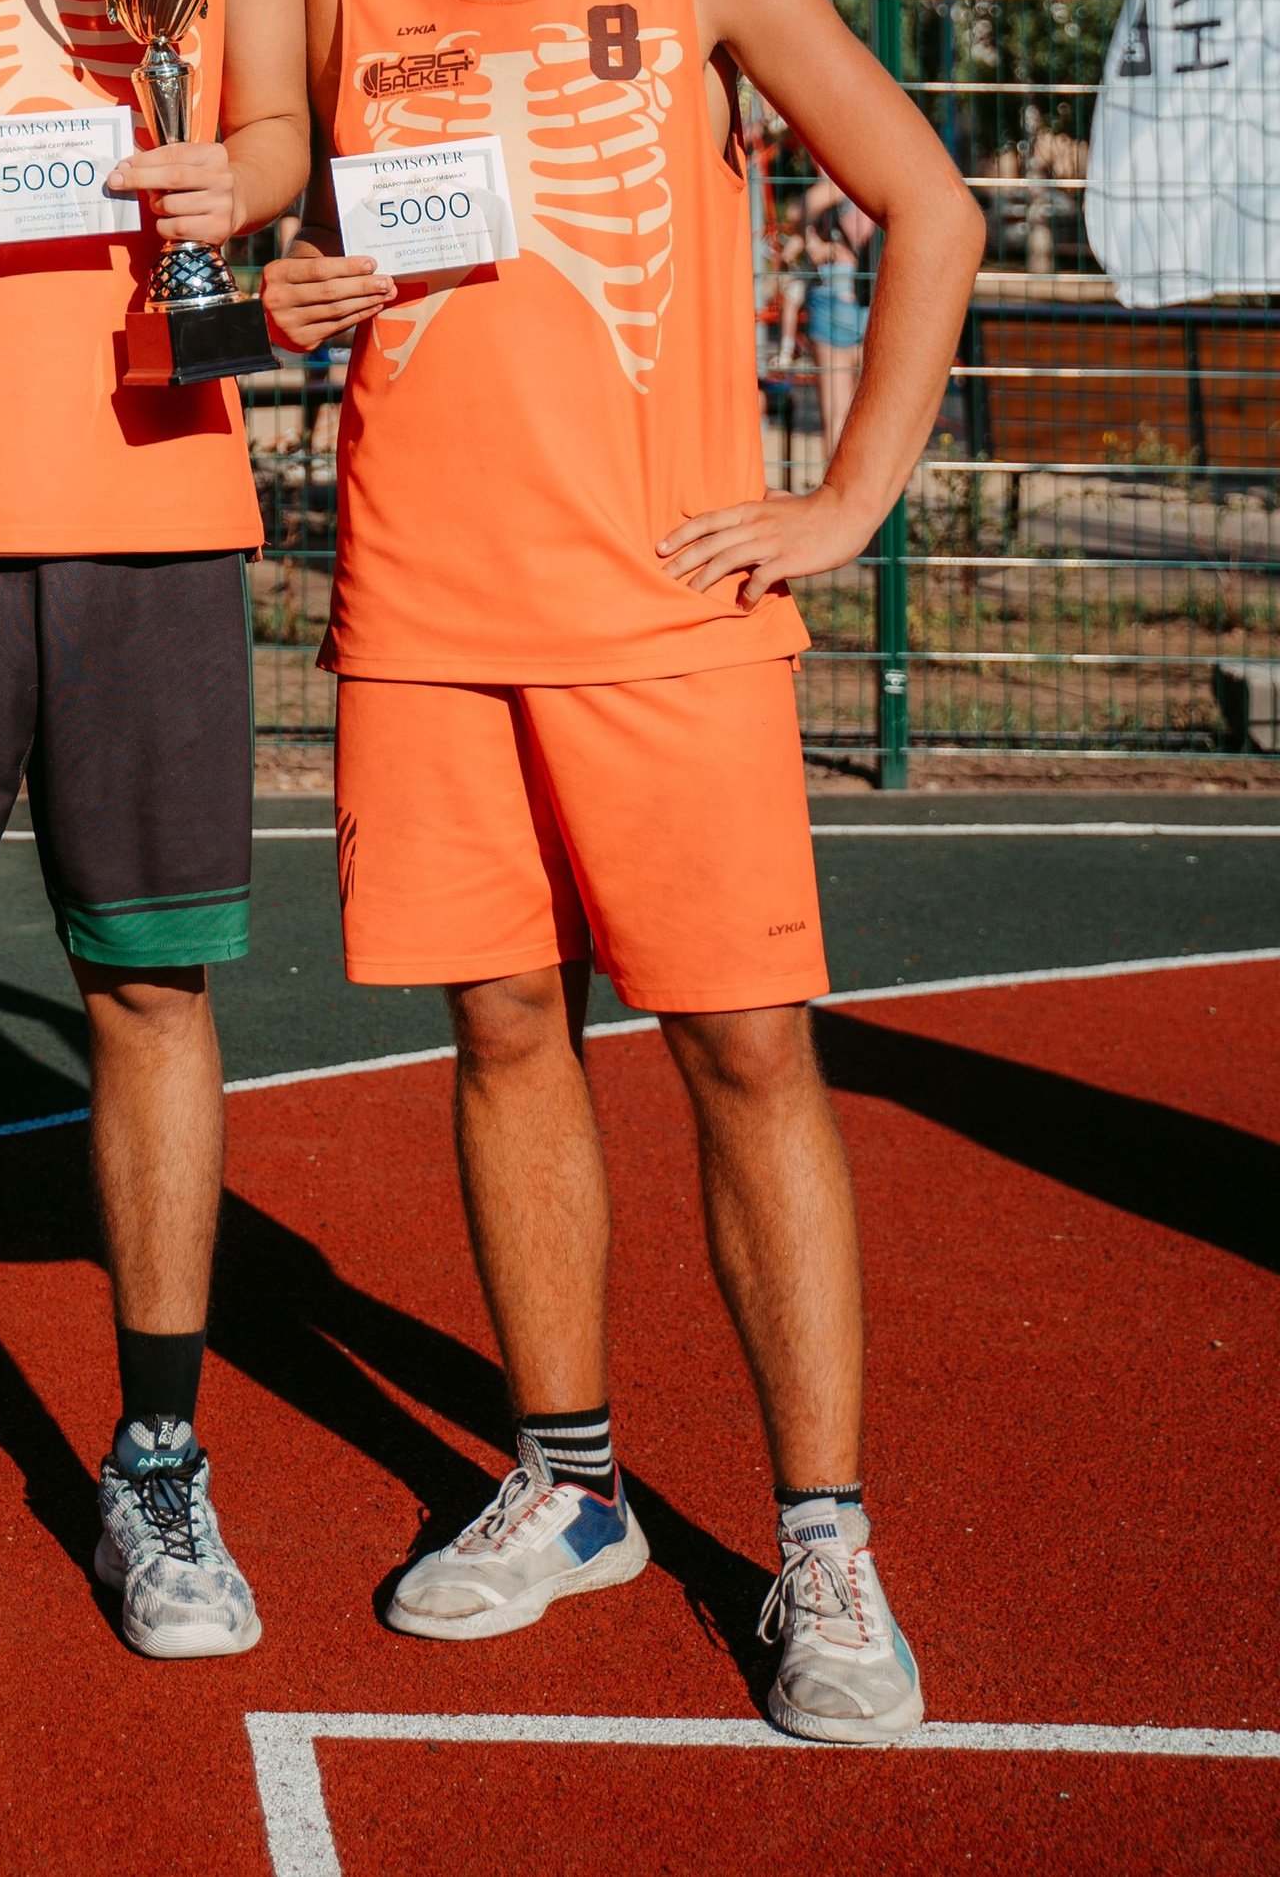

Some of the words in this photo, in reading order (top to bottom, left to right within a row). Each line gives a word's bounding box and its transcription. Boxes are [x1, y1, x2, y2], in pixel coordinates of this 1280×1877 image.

[396, 23, 437, 37] LYKIA
[586, 2, 642, 81] 8
[378, 66, 465, 94] БАСКЕТ
[47, 139, 94, 151] СЕРТИФИКАТ
[369, 150, 464, 175] TOMSOYER
[1, 160, 95, 193] 5000
[372, 177, 422, 190] ПОДАРОЧНЫЙ
[422, 172, 467, 184] СЕРТИФИКАТ
[32, 191, 67, 201] РУБЛЕЙ
[379, 191, 471, 229] 5000
[411, 224, 445, 235] РУБЛЕЙ
[768, 920, 807, 937] LYKIA
[794, 1524, 837, 1542] PUMA
